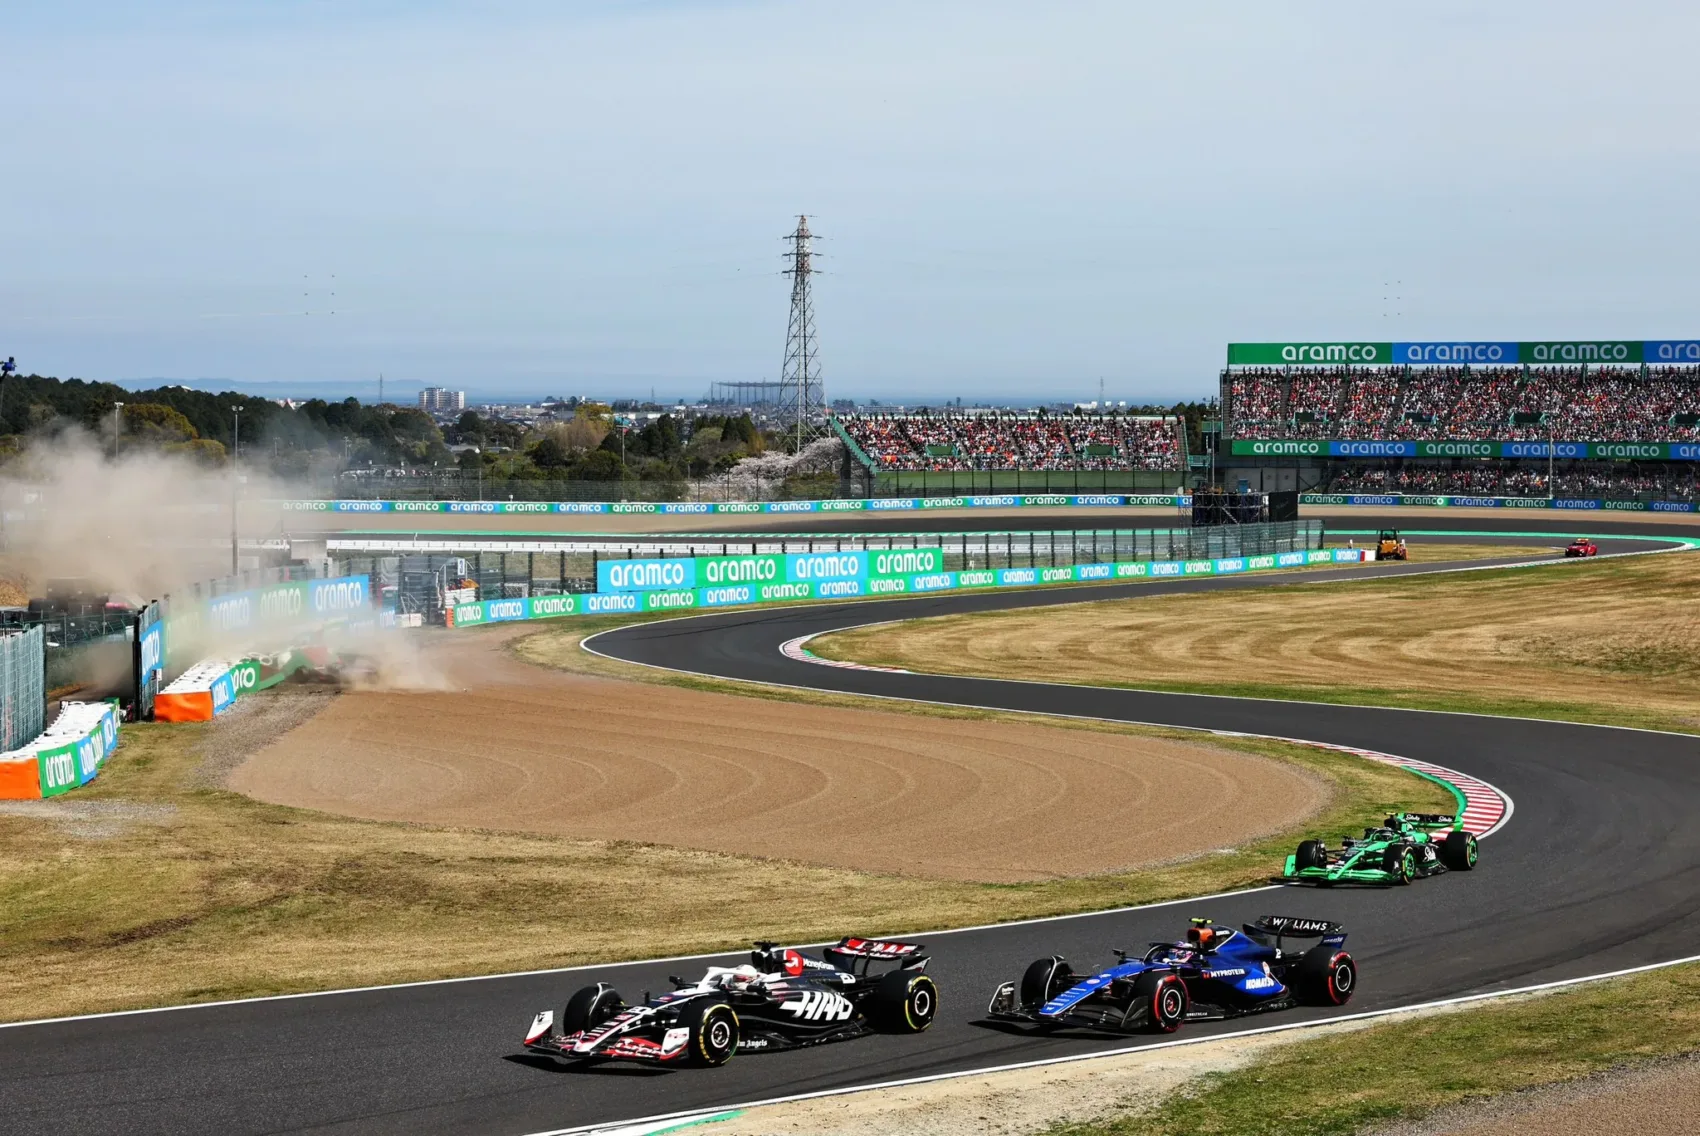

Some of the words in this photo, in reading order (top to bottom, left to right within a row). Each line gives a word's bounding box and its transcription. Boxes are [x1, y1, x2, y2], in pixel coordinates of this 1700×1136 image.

[1282, 346, 1376, 360] aramco
[1408, 346, 1502, 360] aramco
[1534, 345, 1627, 359] aramco
[1254, 443, 1318, 453] aramco
[1340, 444, 1404, 453] aramco
[1426, 444, 1490, 454] aramco
[1512, 445, 1576, 455] aramco
[1597, 446, 1659, 456] aramco
[281, 502, 325, 511] aramco
[396, 502, 438, 510] aramco
[451, 502, 493, 511] aramco
[506, 503, 547, 511] aramco
[560, 503, 601, 511] aramco
[613, 503, 654, 512] aramco
[667, 503, 706, 512] aramco
[719, 503, 759, 512] aramco
[771, 502, 810, 511] aramco
[822, 501, 861, 509] aramco
[873, 499, 912, 508] aramco
[924, 498, 962, 508] aramco
[974, 497, 1013, 505] aramco
[1305, 496, 1343, 505] aramco
[1354, 497, 1392, 505] aramco
[1404, 497, 1444, 506] aramco
[1455, 498, 1494, 507] aramco
[1506, 499, 1545, 508] aramco
[1557, 501, 1595, 509] aramco
[1606, 502, 1643, 510] aramco
[1654, 503, 1688, 512] aramco
[611, 564, 684, 586] aramco
[707, 559, 776, 582] aramco
[796, 556, 858, 578] aramco
[877, 553, 933, 573] aramco
[457, 606, 481, 622] aramco
[491, 602, 522, 618] aramco
[534, 598, 574, 613] aramco
[589, 596, 635, 610] aramco
[650, 593, 693, 607] aramco
[708, 588, 748, 603] aramco
[762, 584, 809, 598] aramco
[820, 582, 858, 595] aramco
[871, 580, 904, 592] aramco
[915, 575, 950, 589] aramco
[960, 573, 993, 585] aramco
[1004, 571, 1034, 582] aramco
[1043, 568, 1071, 580] aramco
[1081, 566, 1109, 577] aramco
[1118, 564, 1145, 575] aramco
[1153, 564, 1178, 574] aramco
[1186, 562, 1211, 573] aramco
[1219, 560, 1242, 571] aramco
[1250, 557, 1273, 568] aramco
[1280, 554, 1303, 564] aramco
[1309, 551, 1330, 562] aramco
[1337, 551, 1357, 560] aramco
[259, 586, 302, 619] aramco
[315, 580, 362, 612] aramco
[1272, 917, 1328, 931] WILIAMS
[1276, 948, 1282, 959] 2
[802, 958, 835, 970] MoneyGram
